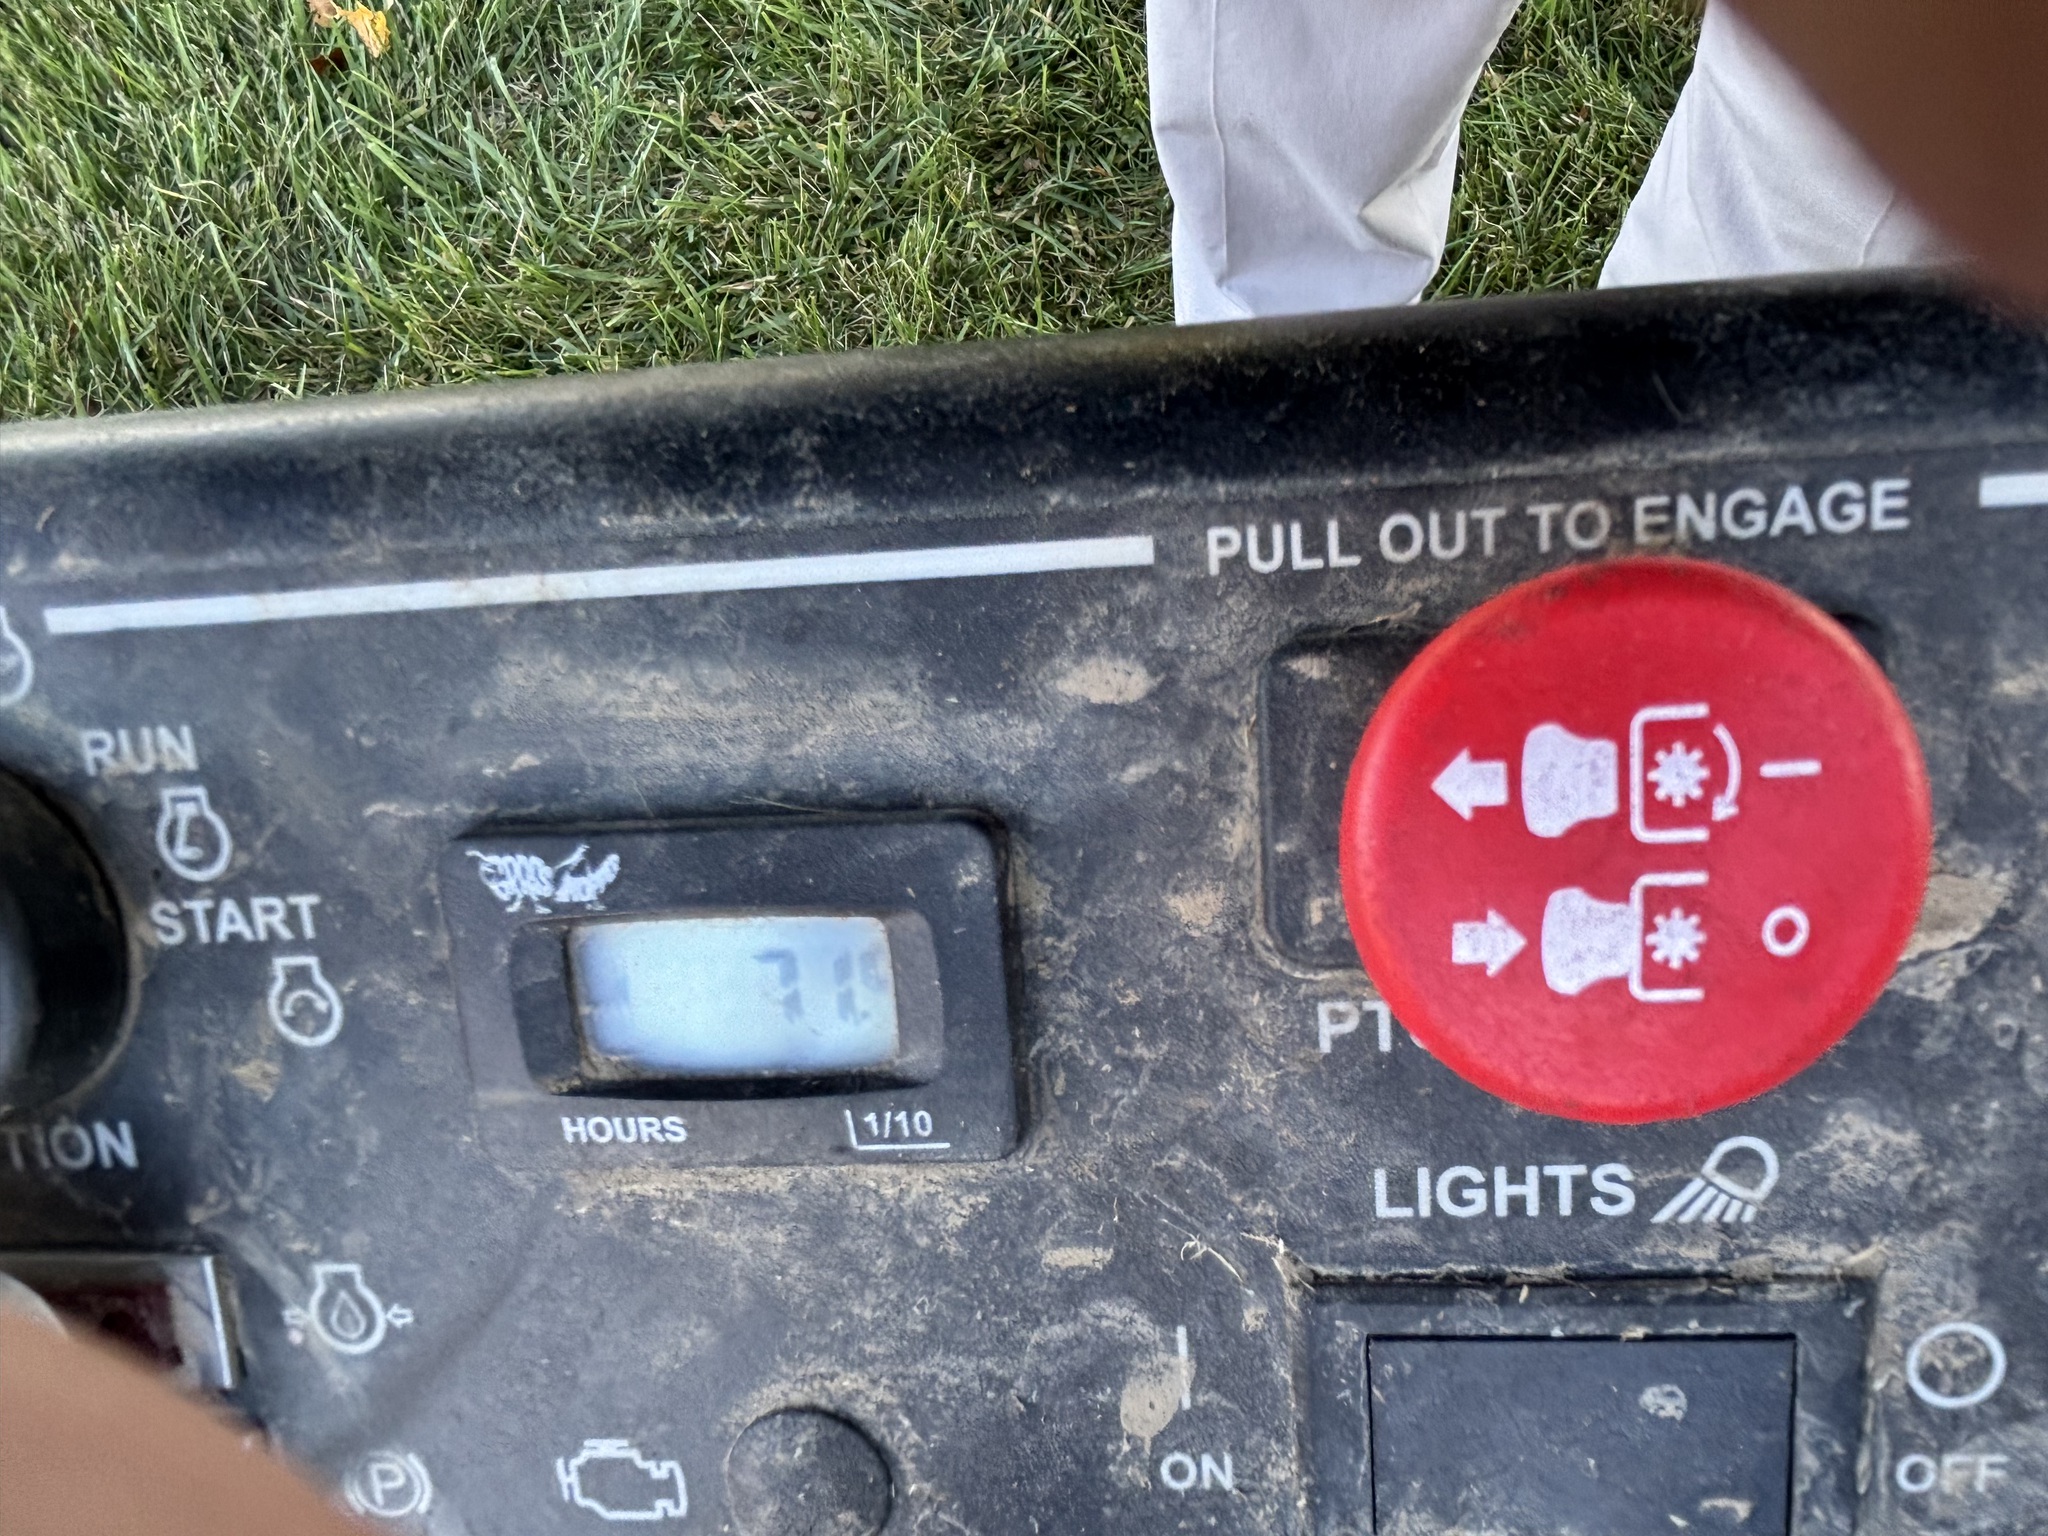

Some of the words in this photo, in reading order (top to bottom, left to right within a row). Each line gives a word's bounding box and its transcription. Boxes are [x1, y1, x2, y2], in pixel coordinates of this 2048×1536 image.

[1206, 518, 1361, 576] PULL
[1379, 507, 1506, 562] OUT
[1526, 500, 1612, 553] TO
[1633, 478, 1912, 544] ENGAGE
[82, 725, 197, 777] RUN
[150, 894, 320, 945] START
[1317, 1000, 1424, 1054] PT
[561, 1115, 688, 1144] HOURS
[863, 1109, 934, 1139] 1/10
[1374, 1162, 1637, 1219] LIGHTS
[1160, 1451, 1234, 1493] ON
[1895, 1452, 2008, 1494] OFF
